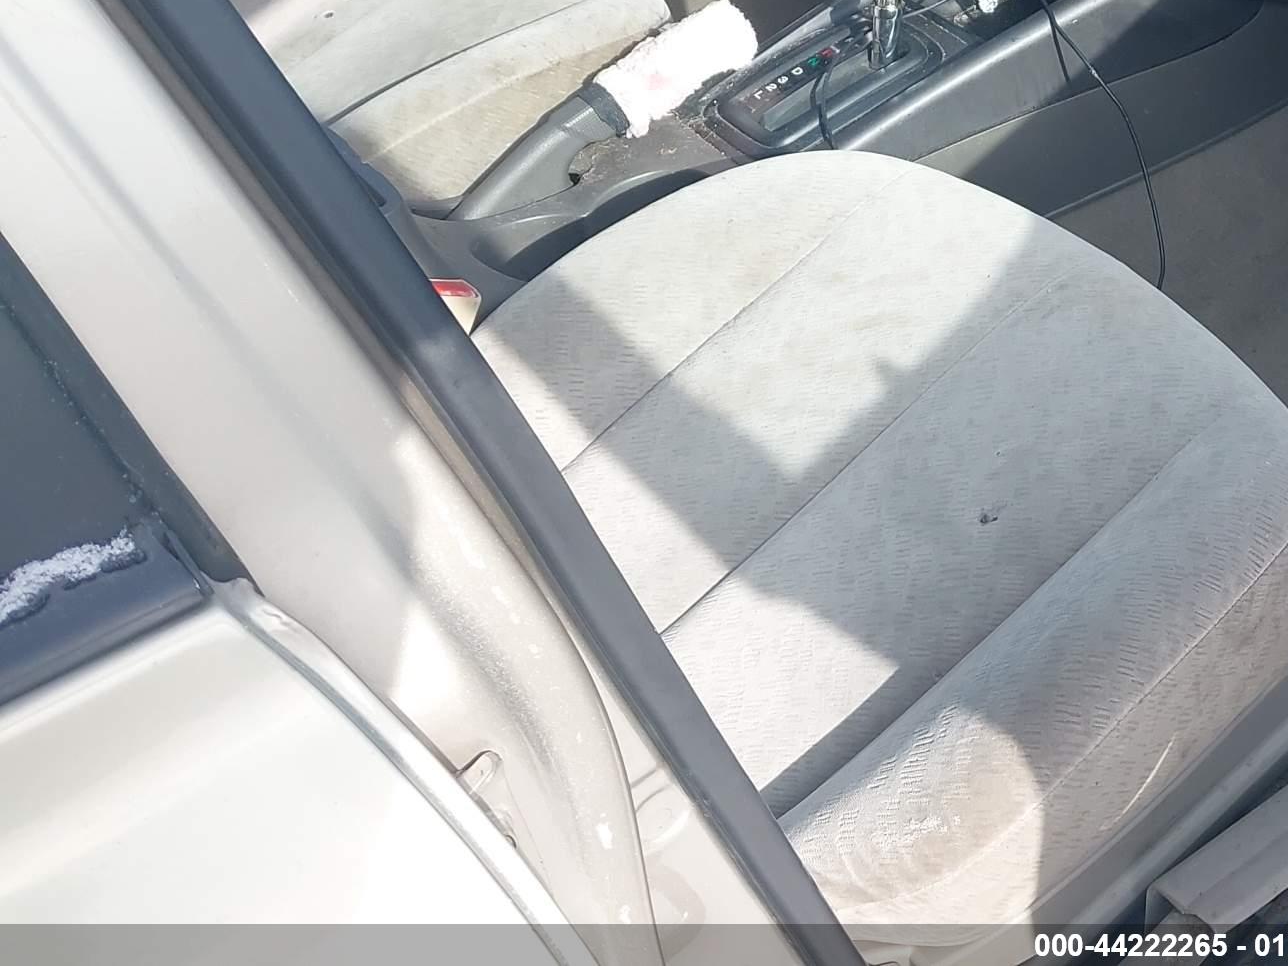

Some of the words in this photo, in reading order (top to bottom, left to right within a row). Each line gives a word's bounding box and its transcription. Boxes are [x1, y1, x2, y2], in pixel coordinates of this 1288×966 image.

[791, 67, 804, 75] D
[777, 76, 788, 84] 3
[765, 84, 777, 92] 2
[754, 90, 763, 99] L
